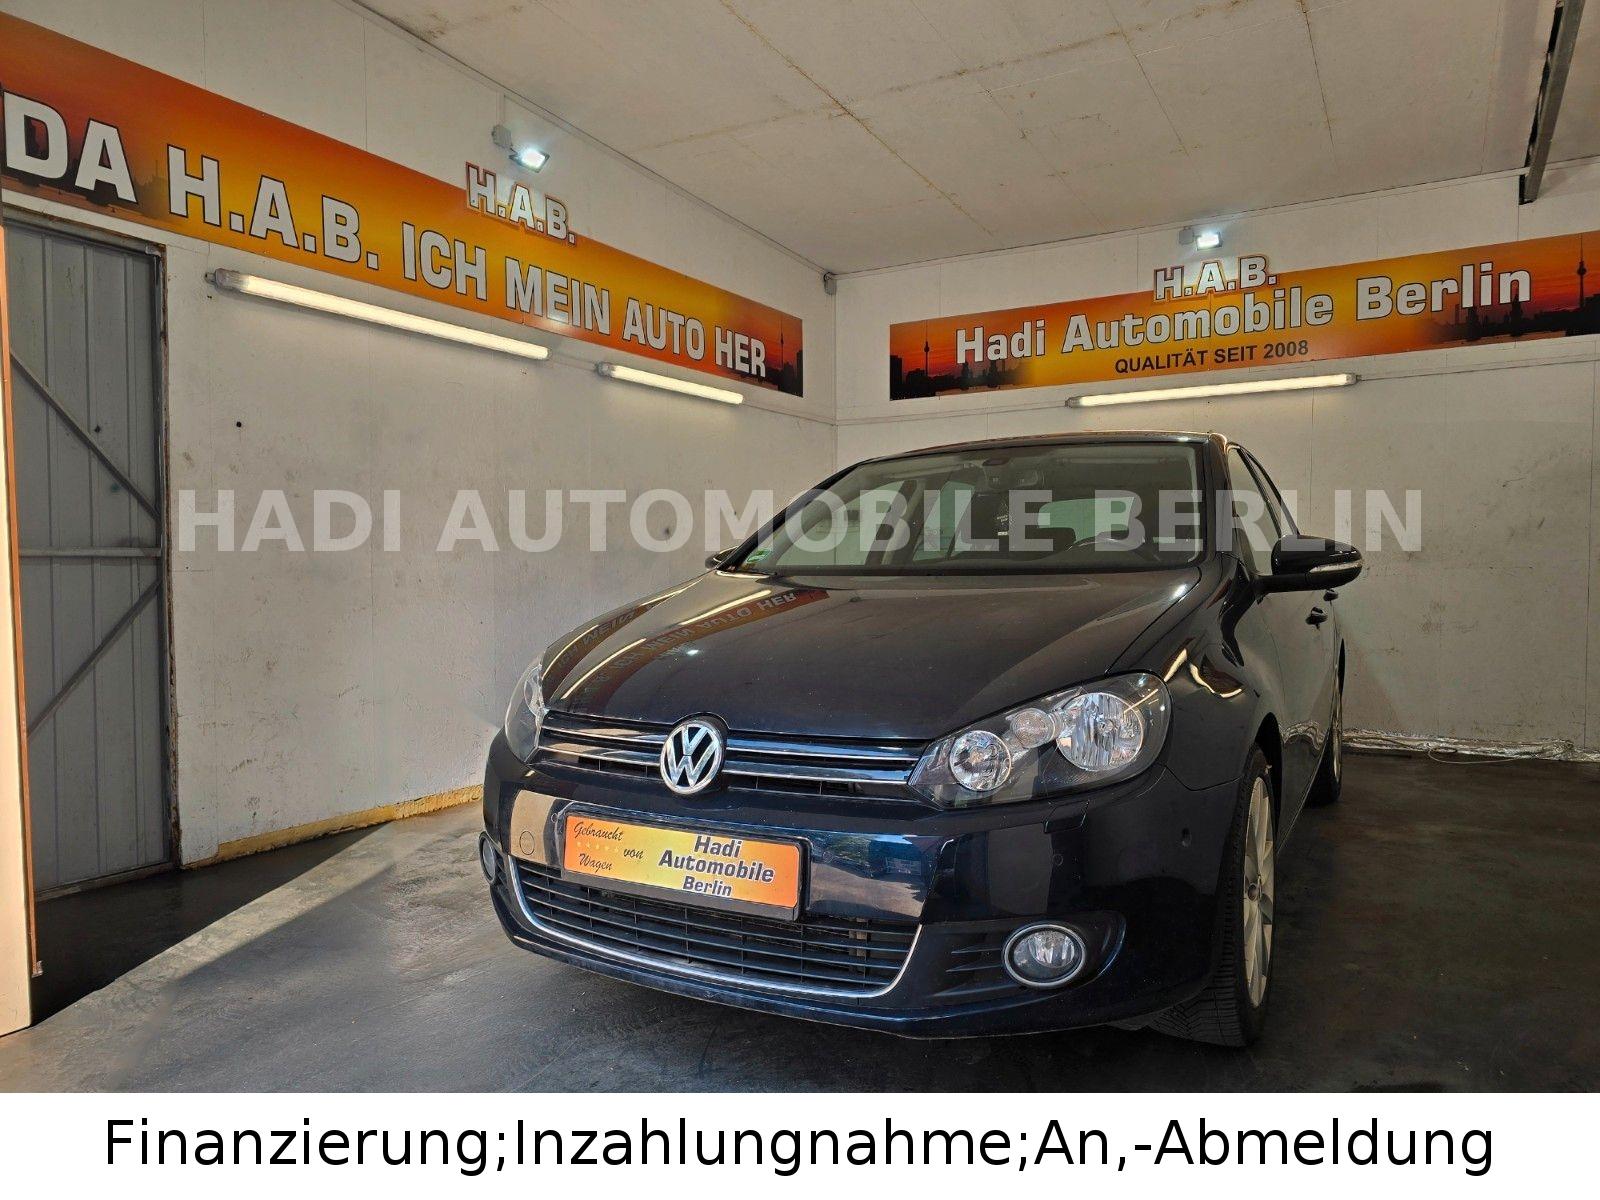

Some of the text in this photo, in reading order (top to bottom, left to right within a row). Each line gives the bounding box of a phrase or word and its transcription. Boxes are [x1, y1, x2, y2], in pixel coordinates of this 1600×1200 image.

[466, 163, 577, 245] H.A.B.
[3, 90, 767, 379] DA H.A.B. ICH MEIN AUTO HER
[1153, 255, 1279, 301] H.A.B.
[955, 261, 1532, 365] Hadi Automobile Berlin
[1114, 340, 1309, 375] QUALITÄT SEIT 2008
[665, 723, 721, 790] VW
[573, 821, 625, 842] Gebraucht
[693, 834, 743, 859] Hadi
[578, 852, 614, 873] Wagen
[623, 847, 645, 861] von
[658, 849, 776, 885] Automobile
[682, 875, 734, 898] Berlin
